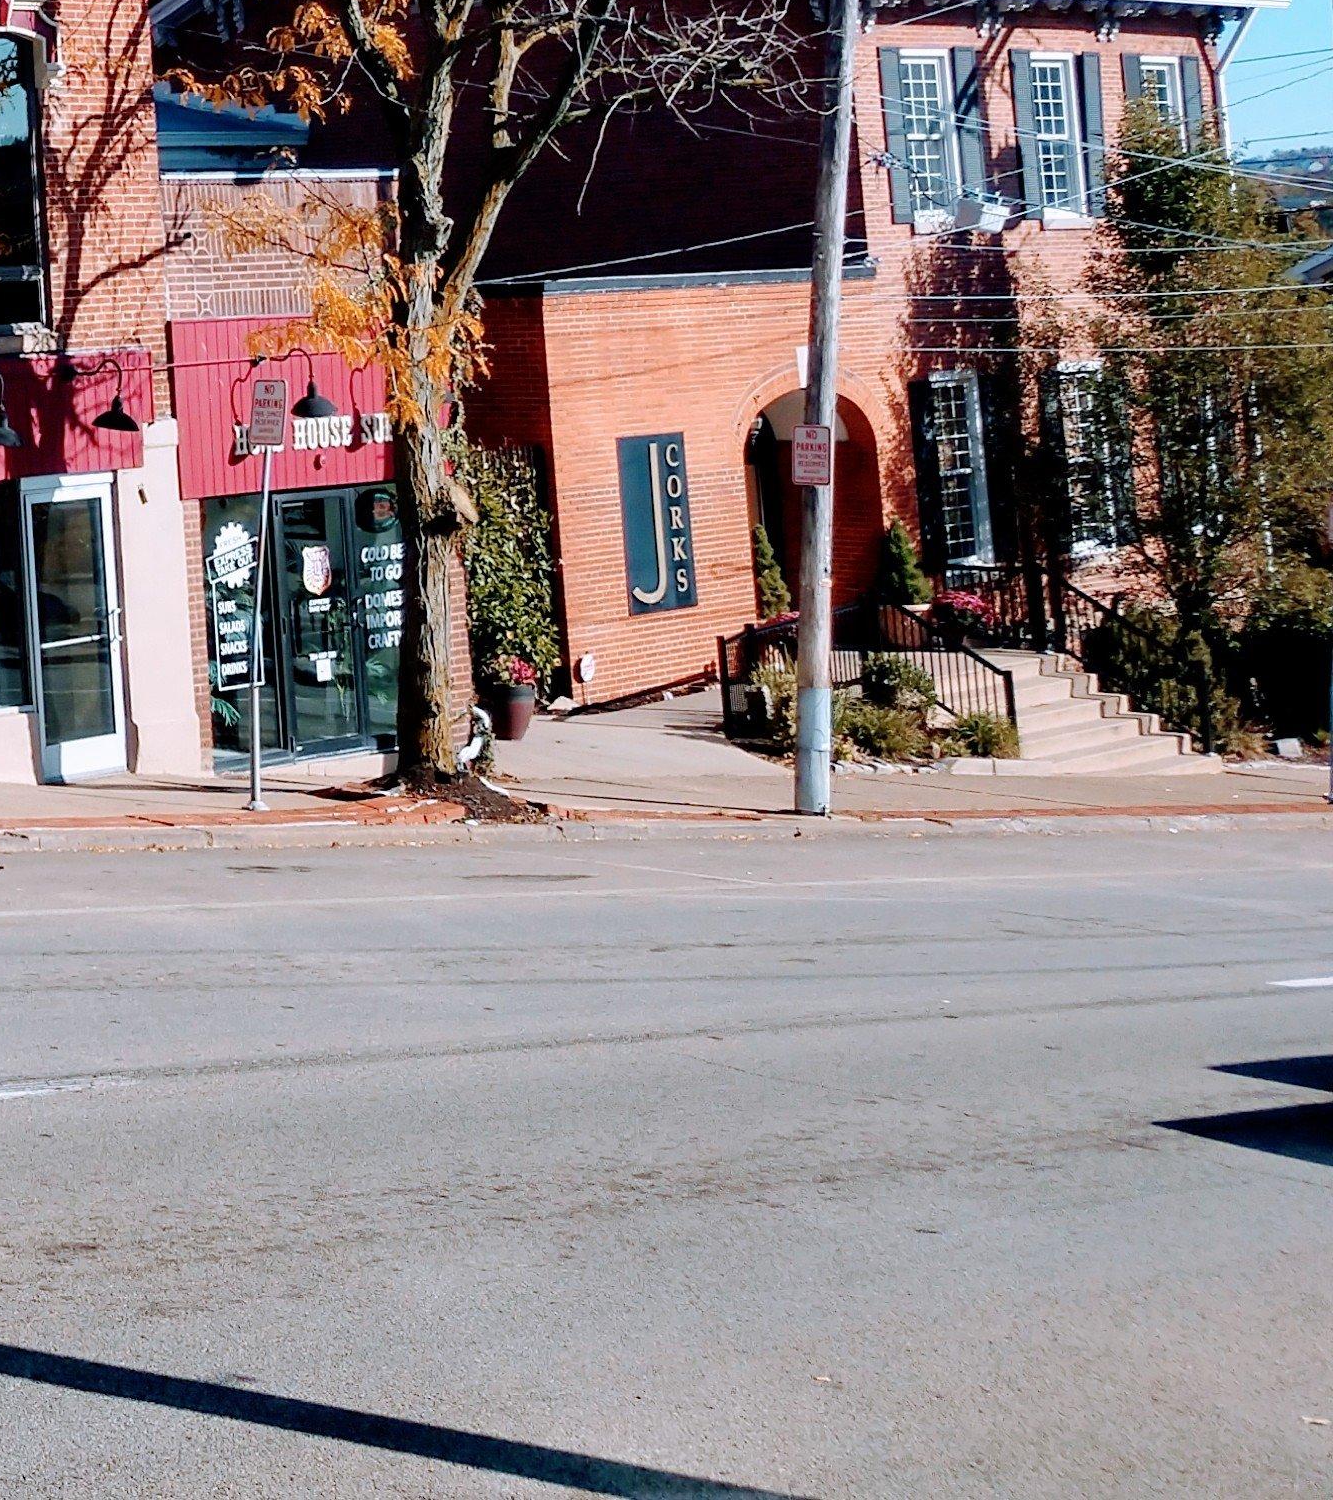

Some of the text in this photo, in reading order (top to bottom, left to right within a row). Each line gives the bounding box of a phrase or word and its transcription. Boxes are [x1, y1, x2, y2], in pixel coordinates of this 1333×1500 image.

[293, 414, 353, 451] HOUSE
[805, 430, 818, 440] NO
[796, 442, 828, 453] PARKING
[633, 442, 668, 605] J
[665, 443, 690, 593] CORKS
[361, 543, 404, 563] COLD BE
[370, 563, 403, 581] TO GO
[217, 601, 237, 615] SUBS
[365, 589, 404, 609] DOMES
[219, 619, 246, 635] SALADS
[366, 610, 402, 629] IMPOR
[220, 641, 248, 656] SNACKS
[221, 660, 249, 676] DRINKS
